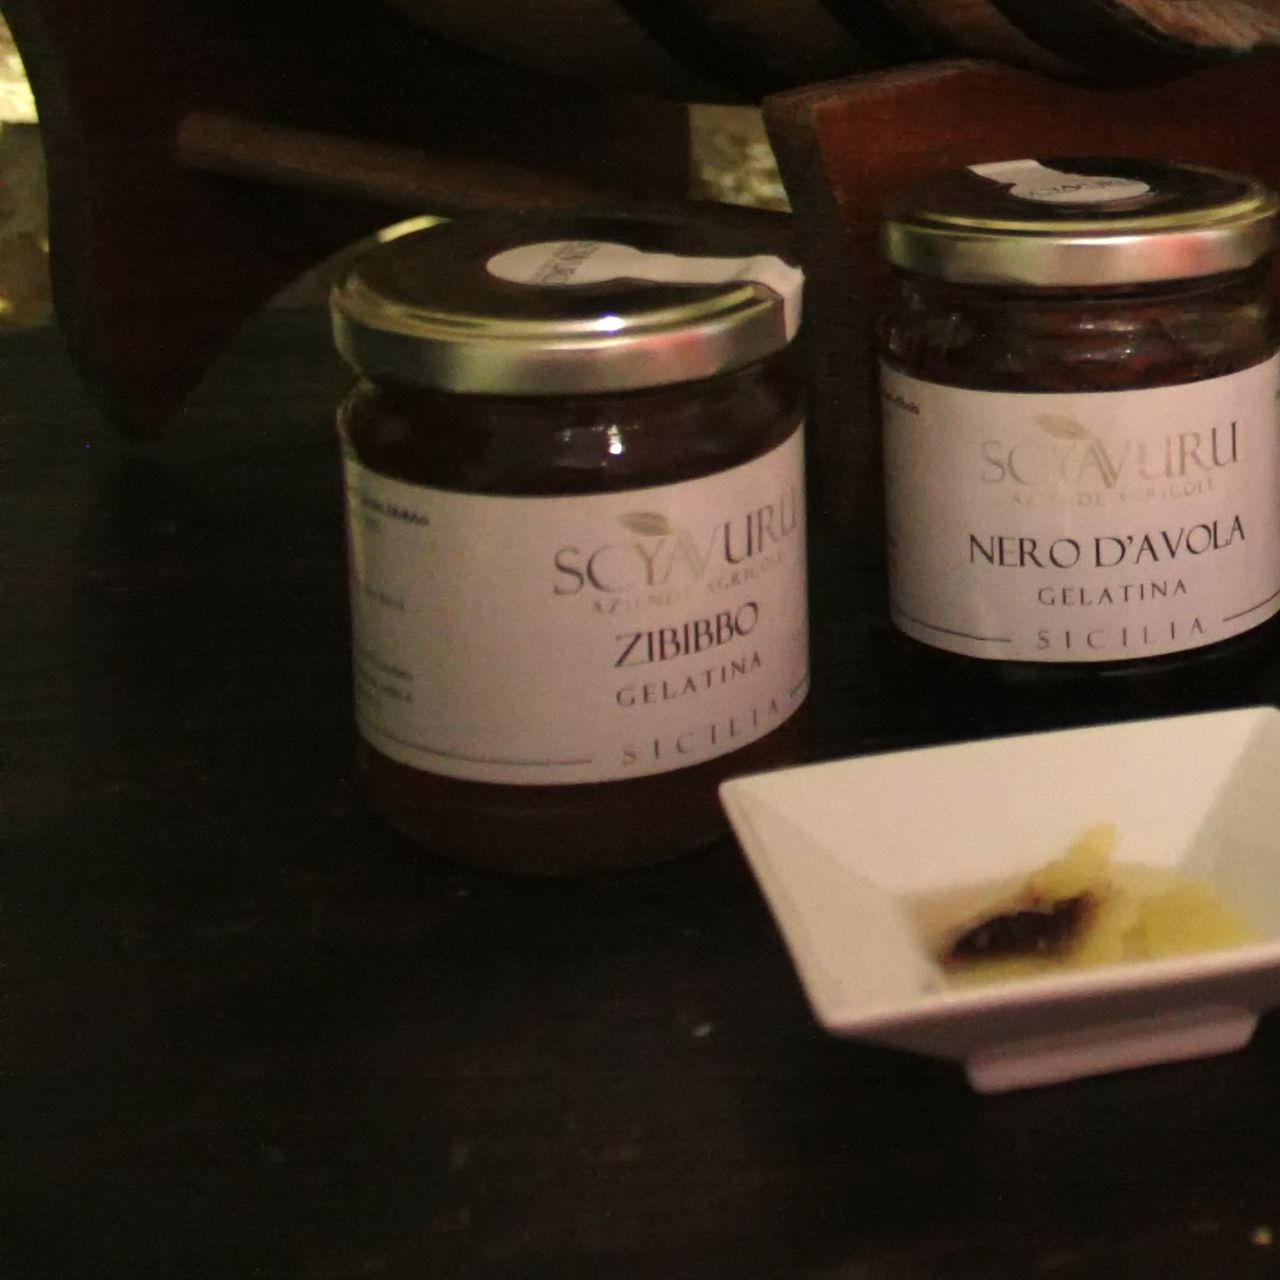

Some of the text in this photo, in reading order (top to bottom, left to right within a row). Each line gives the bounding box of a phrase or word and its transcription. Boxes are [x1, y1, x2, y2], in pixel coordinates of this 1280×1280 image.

[968, 514, 1246, 568] NERO D'AVOLA
[1038, 579, 1188, 607] GELATINA
[614, 601, 760, 668] ZIBIBBO
[1037, 616, 1205, 651] SICILIA
[615, 650, 763, 708] GELATINA
[622, 697, 780, 766] SICILIA
